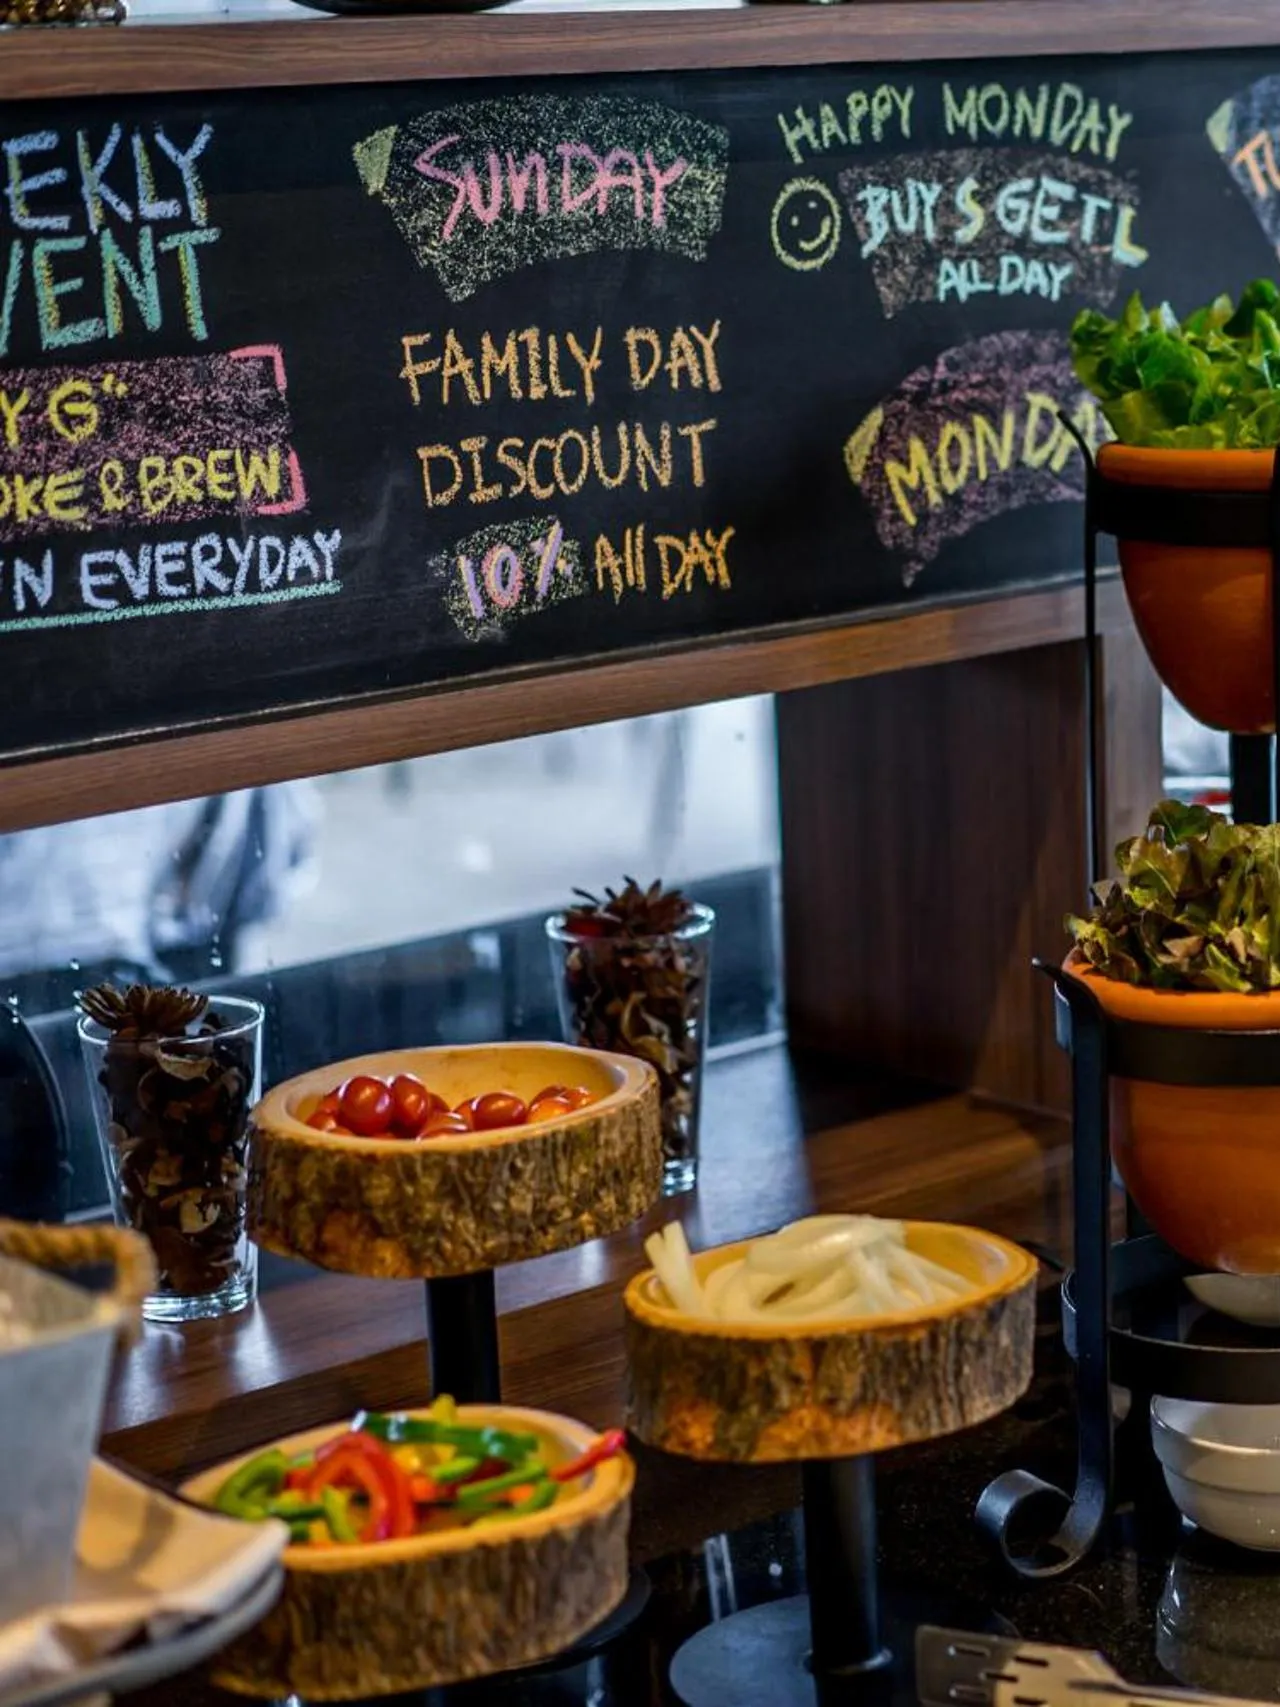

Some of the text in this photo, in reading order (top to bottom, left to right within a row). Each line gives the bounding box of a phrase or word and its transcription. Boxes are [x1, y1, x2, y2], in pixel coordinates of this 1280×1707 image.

[778, 82, 1133, 163] HAPPY MONDAY
[2, 121, 214, 235] EKLY
[414, 134, 689, 240] SUNDAY
[856, 177, 942, 259] BUY
[995, 176, 1112, 245] GET
[936, 255, 1075, 303] ALL DAY
[399, 319, 723, 406] FAMILY DAY
[139, 448, 281, 517] BREW
[416, 417, 718, 508] DISCOUNT
[884, 391, 1119, 526] MONDA
[0, 529, 341, 612] N EVERYDAY
[457, 519, 574, 619] 10%
[653, 525, 736, 600] DAY
